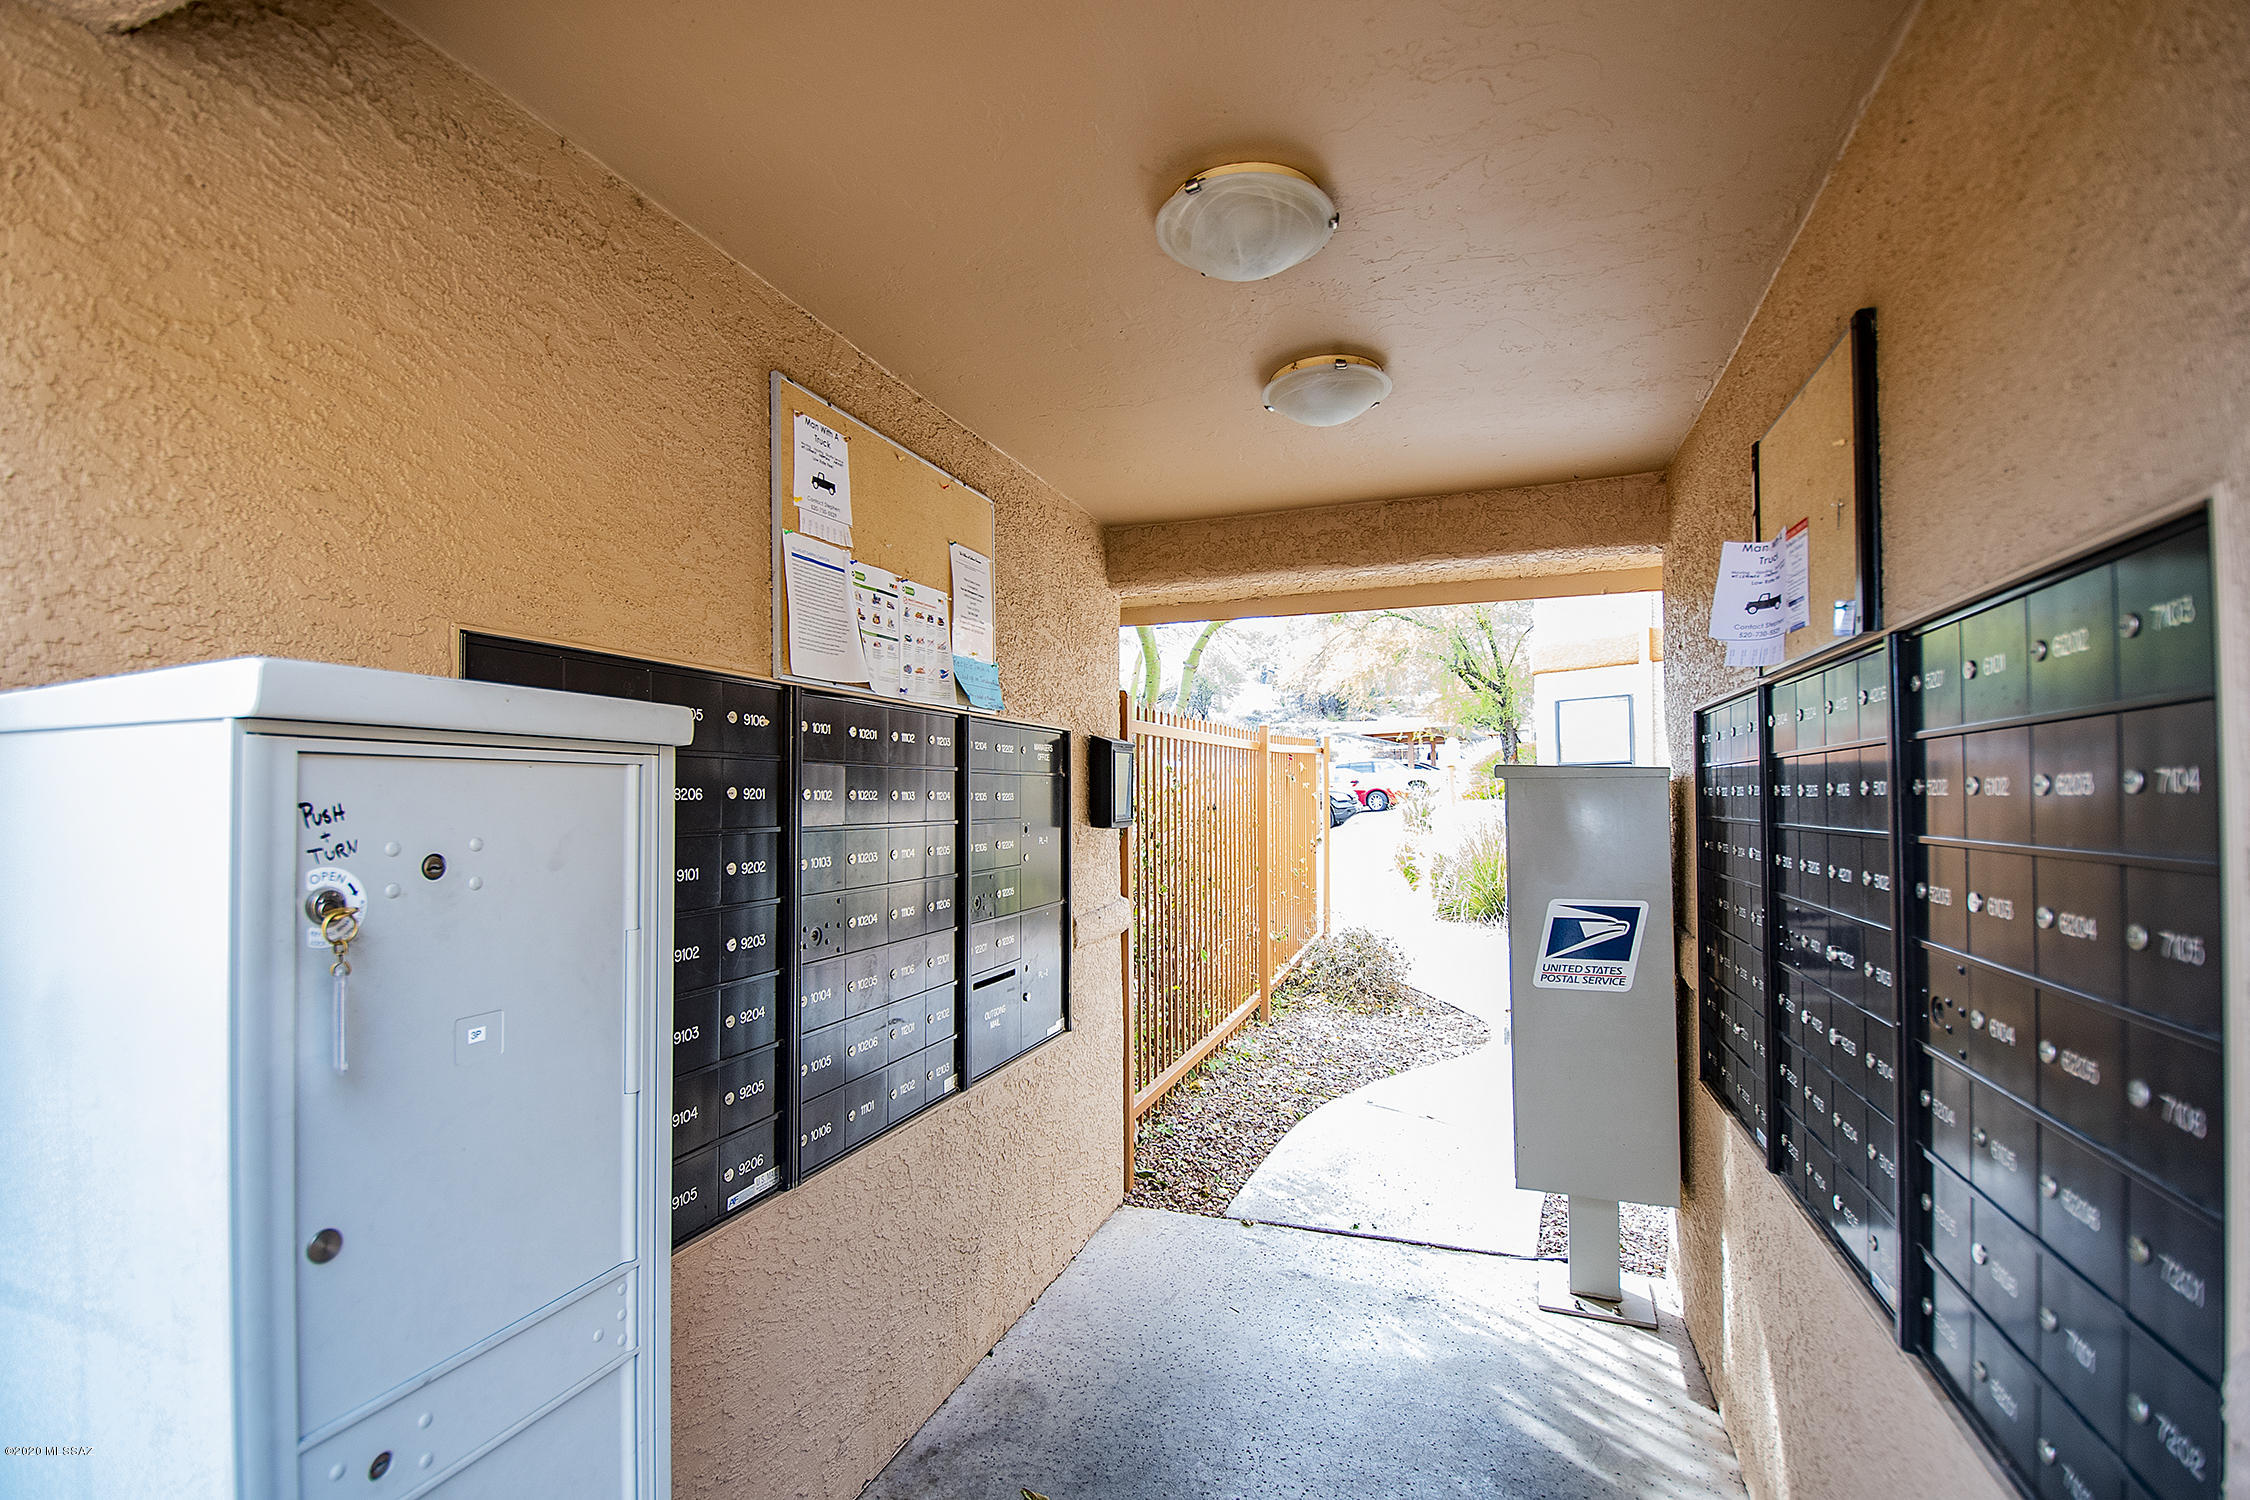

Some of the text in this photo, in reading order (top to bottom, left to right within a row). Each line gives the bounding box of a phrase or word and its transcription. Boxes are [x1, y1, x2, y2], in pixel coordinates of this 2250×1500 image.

[1742, 544, 1769, 552] Man
[743, 713, 766, 727] 9106
[812, 723, 831, 735] 10101
[858, 728, 878, 740] 10201
[2153, 765, 2200, 795] 7104
[674, 787, 704, 801] 8206
[743, 788, 766, 800] 9201
[812, 789, 833, 801] 10102
[857, 789, 878, 801] 10202
[298, 801, 345, 829] PUSH
[306, 839, 359, 864] TURN
[857, 852, 878, 863] 10203
[741, 861, 766, 874] 9202
[811, 857, 832, 869] 10103
[310, 872, 346, 885] OPEN
[676, 868, 699, 882] 9101
[857, 914, 878, 927] 10204
[740, 934, 766, 950] 9203
[674, 946, 700, 962] 9102
[1542, 963, 1623, 975] UNITED STATES
[857, 976, 878, 990] 10205
[1540, 974, 1626, 986] POSTAL SERVICE
[811, 988, 831, 1004] 10104
[740, 1006, 766, 1024] 9204
[673, 1026, 700, 1045] 9103
[858, 1037, 878, 1053] 10206
[811, 1055, 832, 1073] 10105
[739, 1081, 765, 1100] 9205
[672, 1107, 699, 1127] 9104
[811, 1123, 832, 1142] 10106
[738, 1154, 764, 1176] 9206
[672, 1187, 698, 1210] 9105
